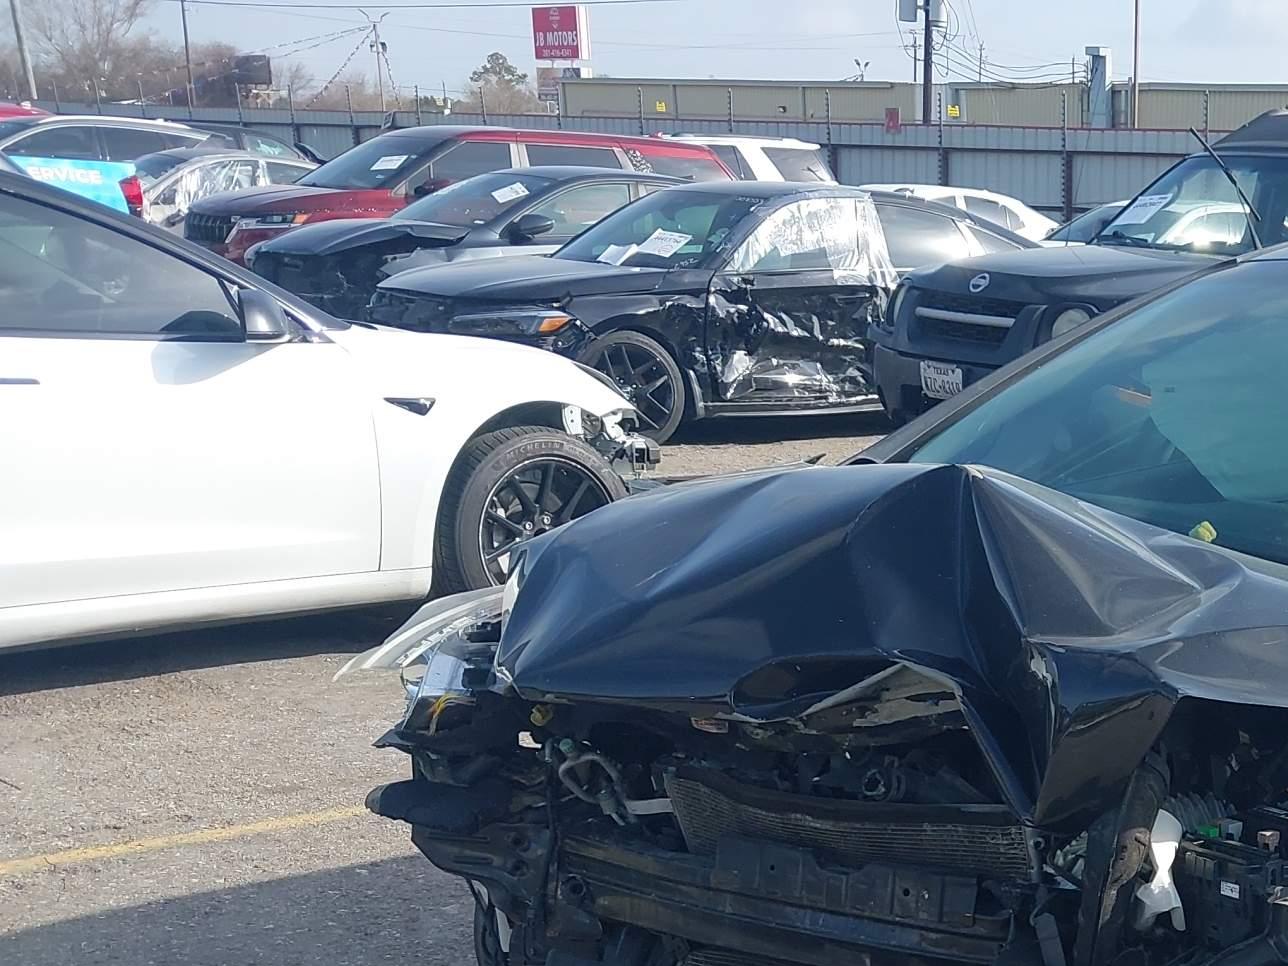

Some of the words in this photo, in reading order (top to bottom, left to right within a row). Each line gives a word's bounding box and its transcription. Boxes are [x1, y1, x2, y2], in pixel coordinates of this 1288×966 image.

[536, 32, 545, 47] JB
[547, 31, 577, 46] MOTORS
[27, 166, 103, 185] ERVICE
[933, 367, 949, 376] TEXAS
[505, 442, 561, 458] MICHELIN
